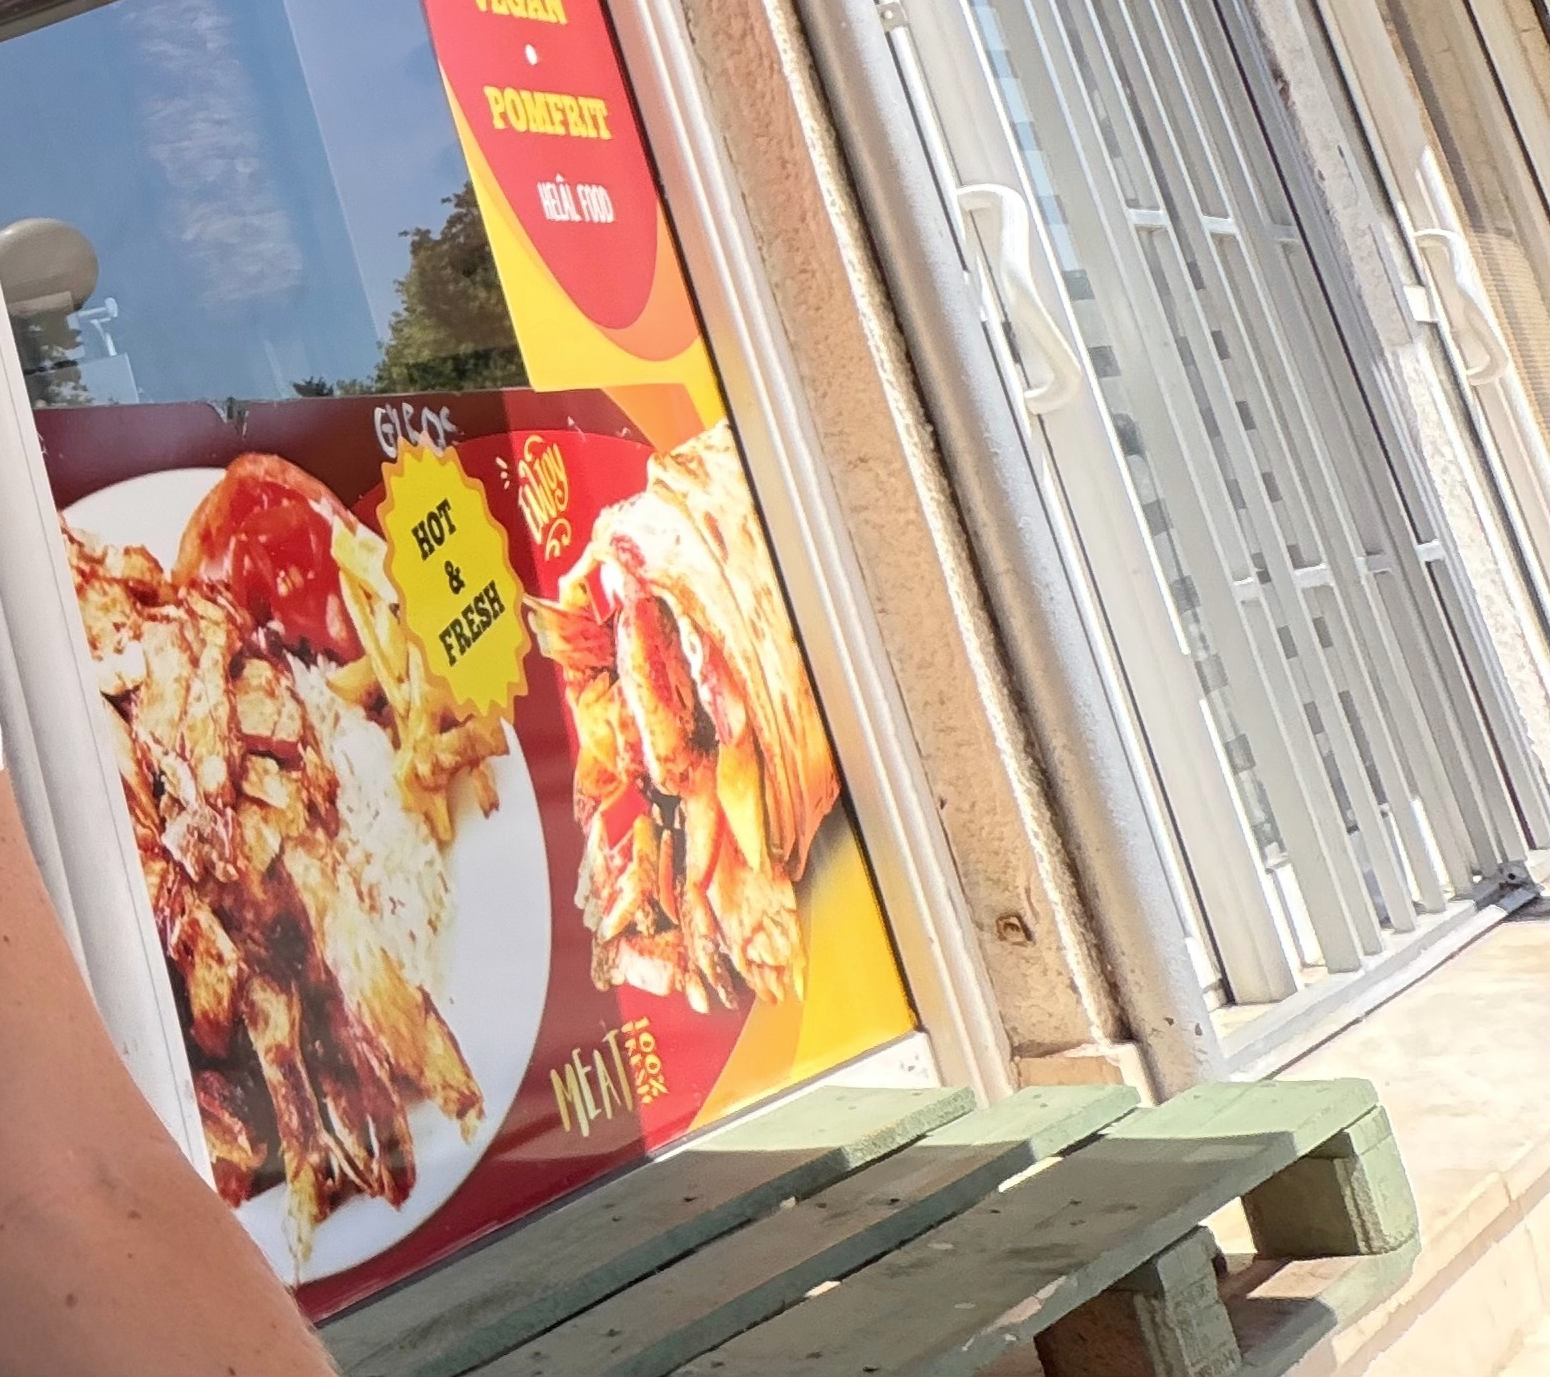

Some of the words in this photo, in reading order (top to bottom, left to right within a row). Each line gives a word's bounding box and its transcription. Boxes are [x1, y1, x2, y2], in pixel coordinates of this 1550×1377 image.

[483, 85, 613, 140] POMFRIT
[576, 183, 615, 224] FOOD
[411, 497, 457, 561] HOT
[444, 559, 466, 595] &
[438, 578, 506, 667] FRESH
[549, 1028, 633, 1138] MEAT
